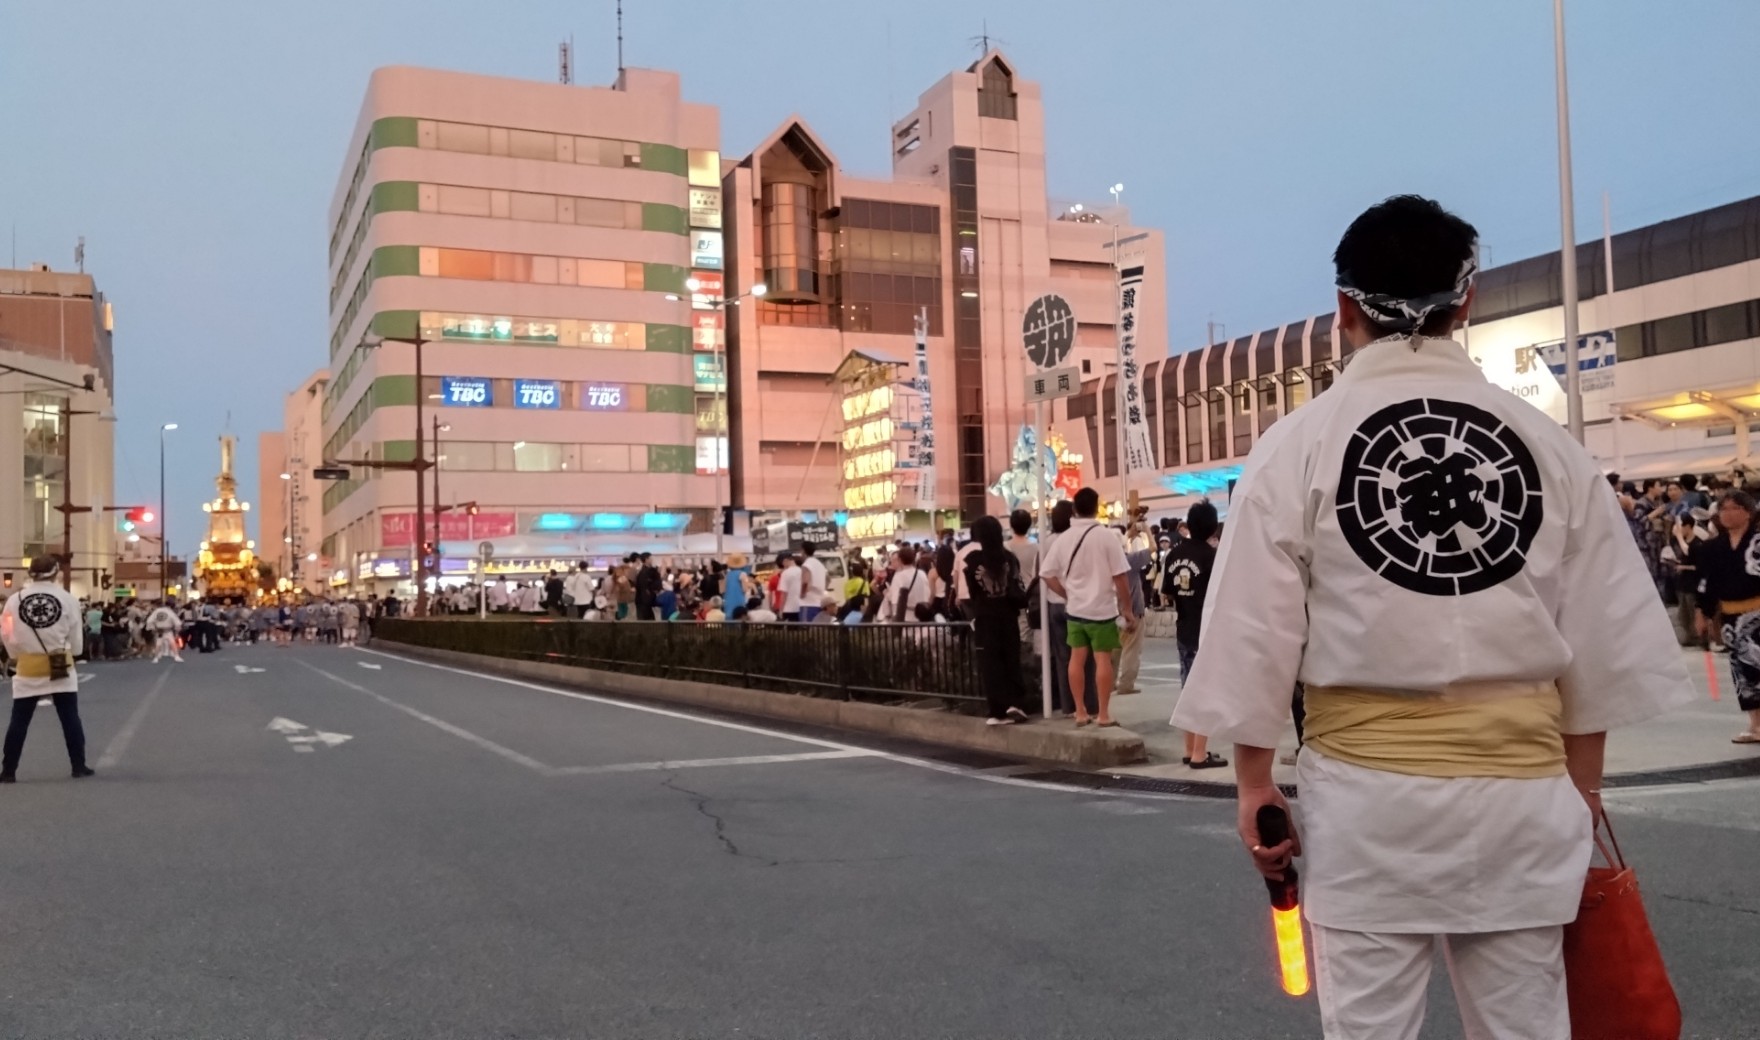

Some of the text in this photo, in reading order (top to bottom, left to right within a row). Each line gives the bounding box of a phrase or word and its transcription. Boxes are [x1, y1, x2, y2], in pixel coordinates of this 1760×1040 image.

[1034, 374, 1070, 395] 車両
[450, 387, 486, 403] TBC
[520, 389, 555, 405] TBC
[588, 391, 621, 406] TBC
